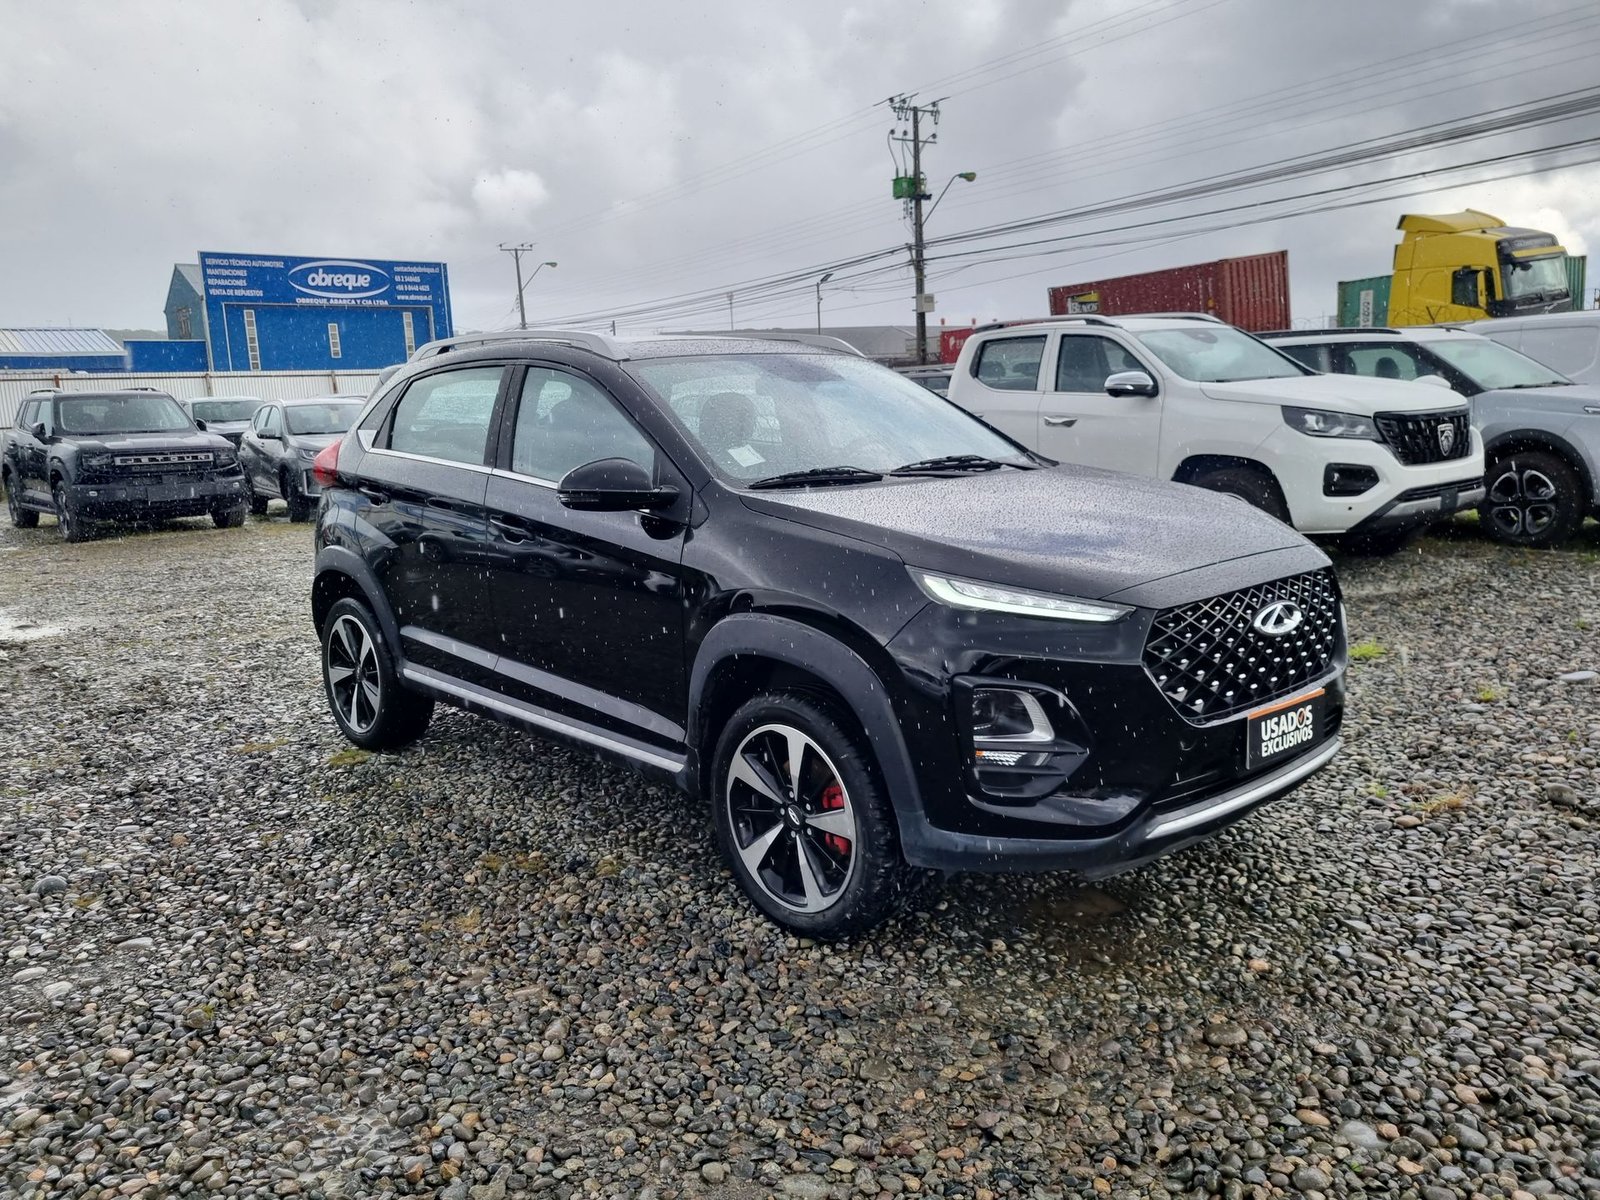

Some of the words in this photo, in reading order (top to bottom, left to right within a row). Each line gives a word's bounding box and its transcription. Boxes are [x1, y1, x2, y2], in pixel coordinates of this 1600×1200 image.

[206, 268, 247, 276] MANTENCIONES
[252, 260, 284, 268] AUTOMOTRIZ
[307, 268, 371, 291] obreque
[209, 288, 226, 296] VENTA
[234, 289, 263, 297] REPUESTOS
[1261, 704, 1313, 741] USADOS
[1261, 724, 1313, 758] EXCLUSIVOS
